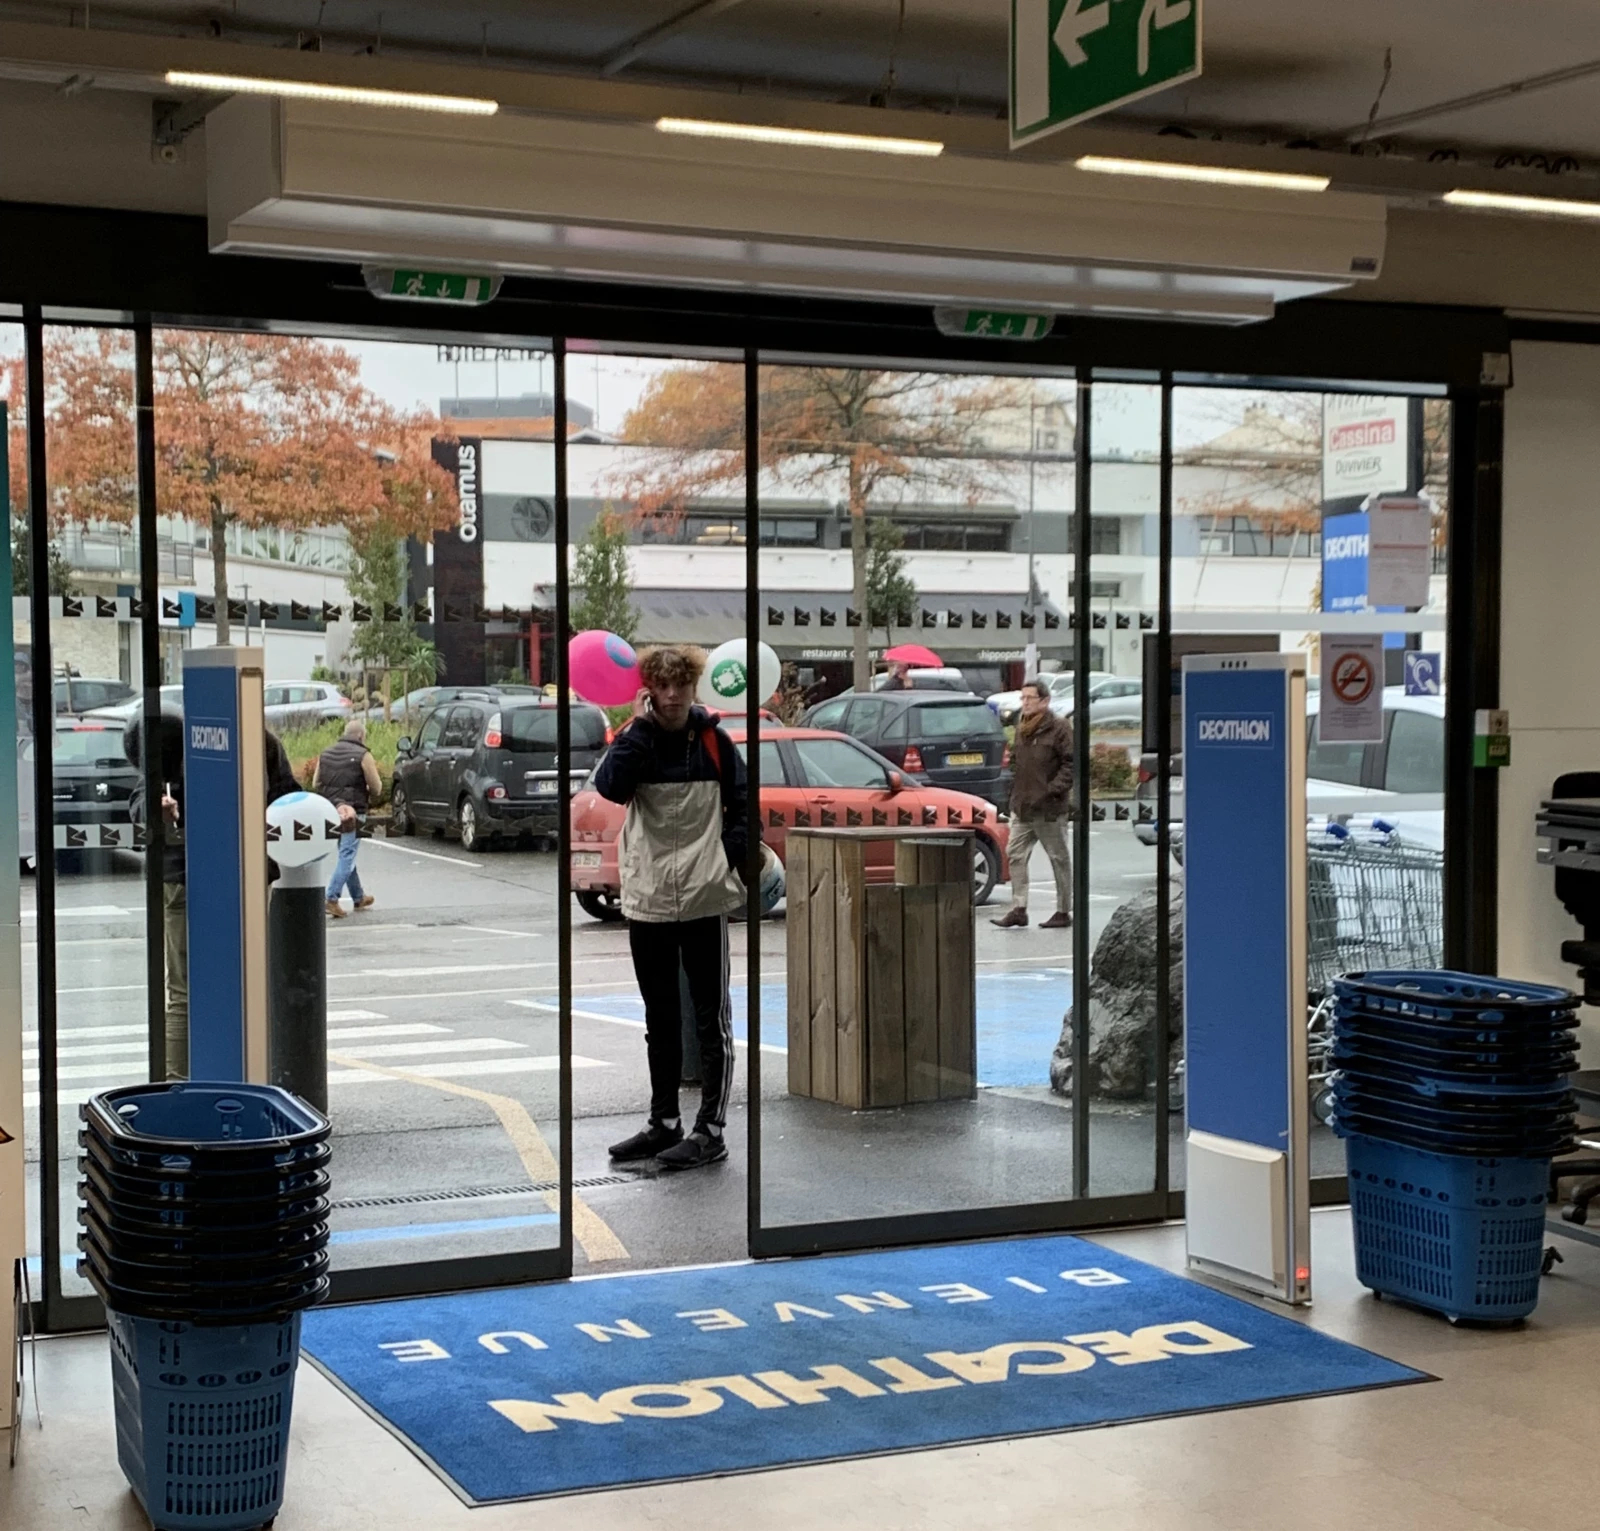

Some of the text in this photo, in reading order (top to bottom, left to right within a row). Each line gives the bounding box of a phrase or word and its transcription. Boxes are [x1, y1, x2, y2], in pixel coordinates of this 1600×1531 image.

[1331, 423, 1392, 449] Cassina
[1324, 533, 1369, 561] DECATH
[802, 649, 847, 658] restaurant
[191, 725, 229, 751] DECATHLON
[1198, 719, 1270, 741] DECATHLON
[487, 1320, 1254, 1433] DECATHLON
